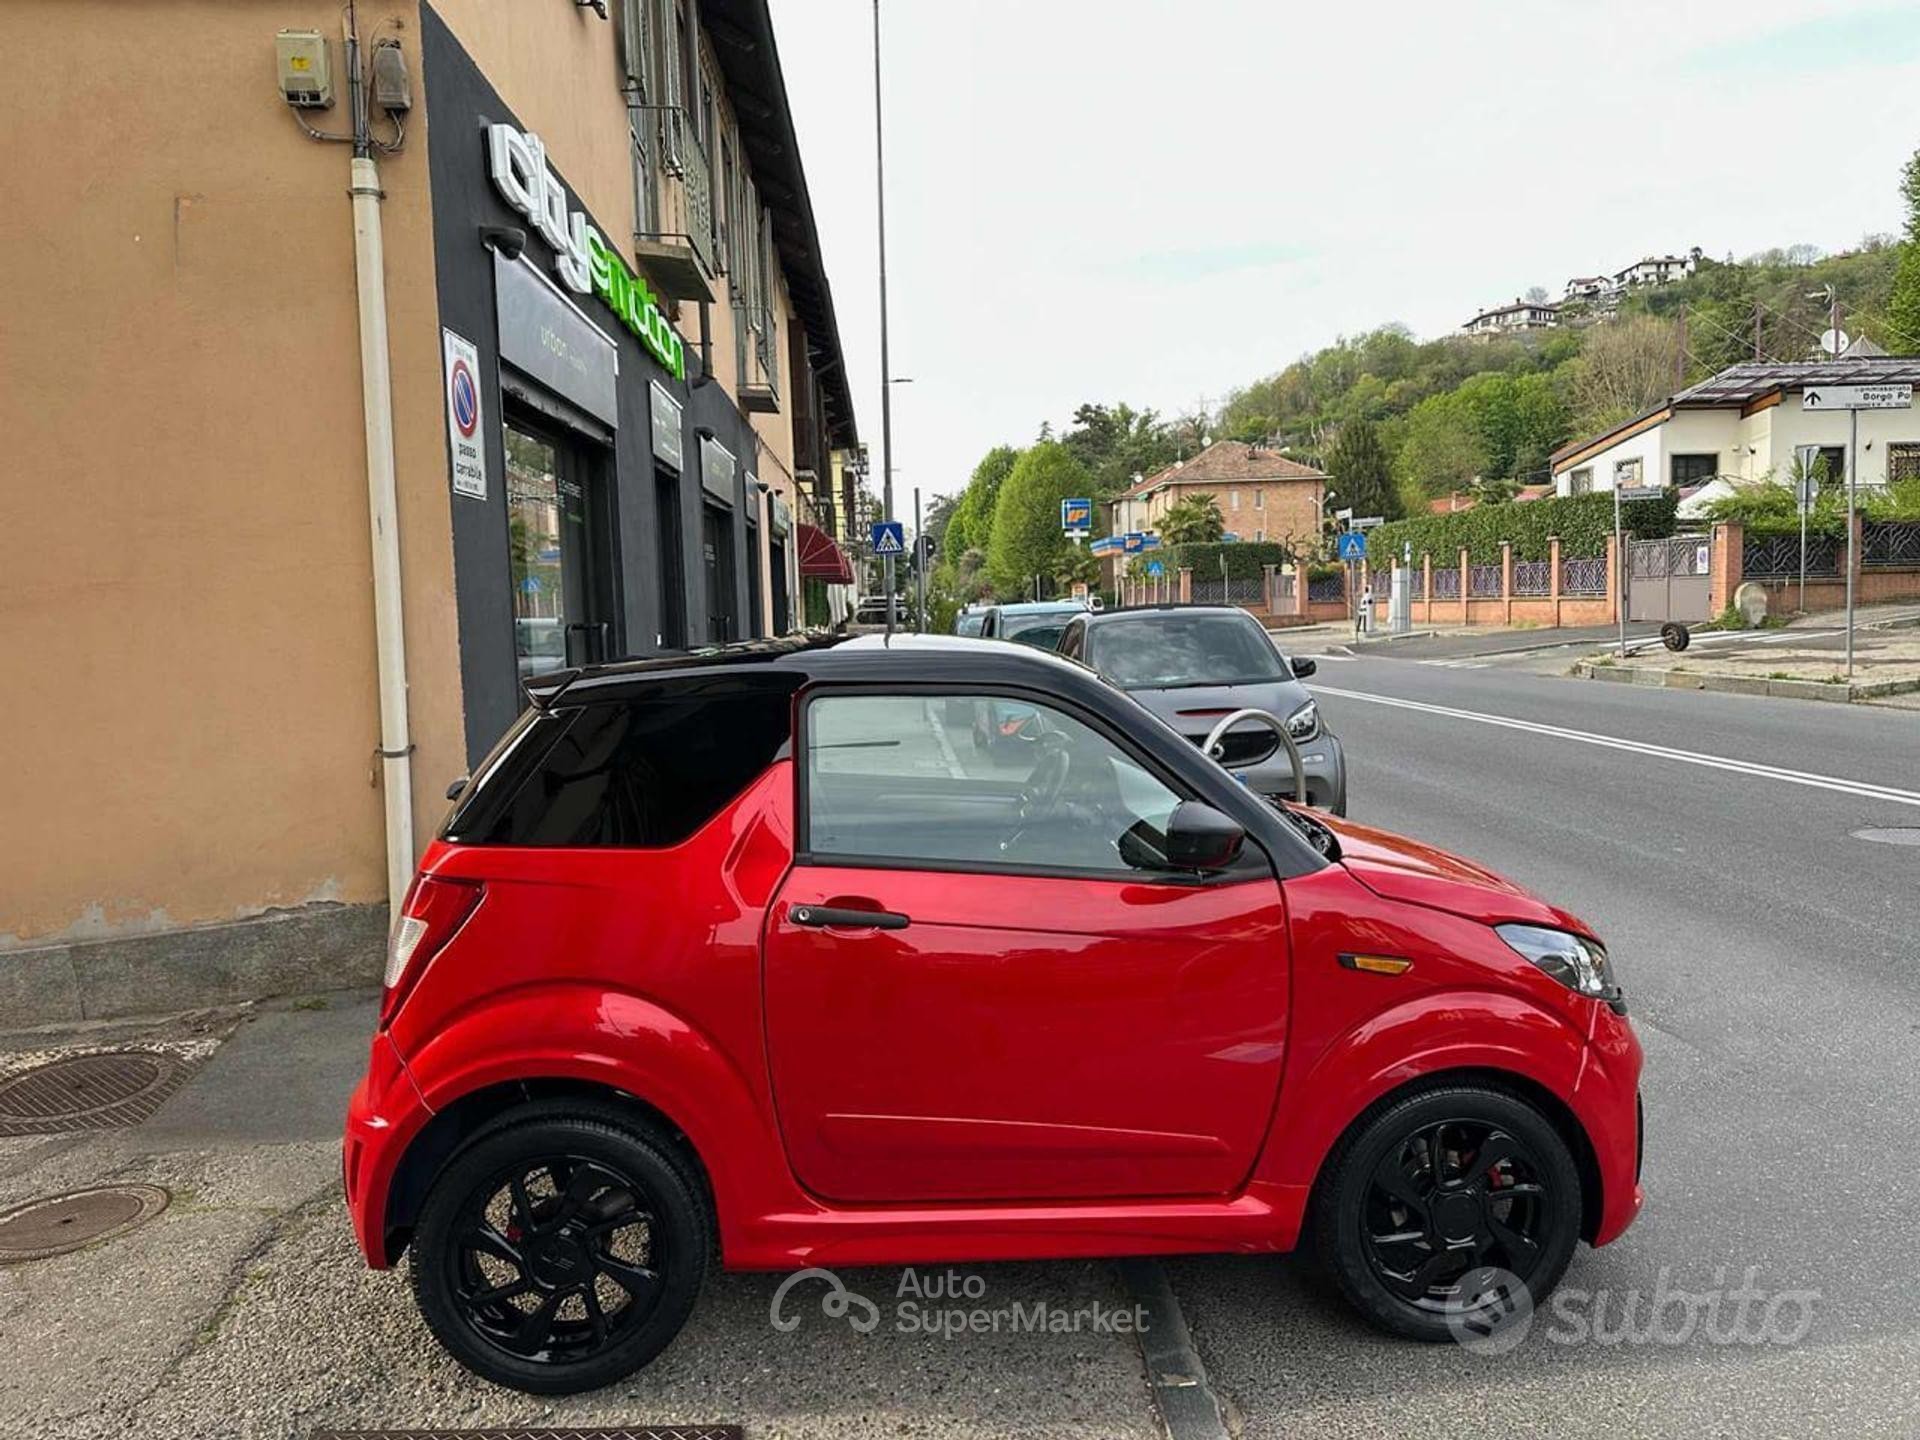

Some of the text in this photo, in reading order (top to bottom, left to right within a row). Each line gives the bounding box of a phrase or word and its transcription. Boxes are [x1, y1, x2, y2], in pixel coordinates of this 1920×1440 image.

[1862, 390, 1911, 402] Borgo Po
[458, 442, 477, 459] passo
